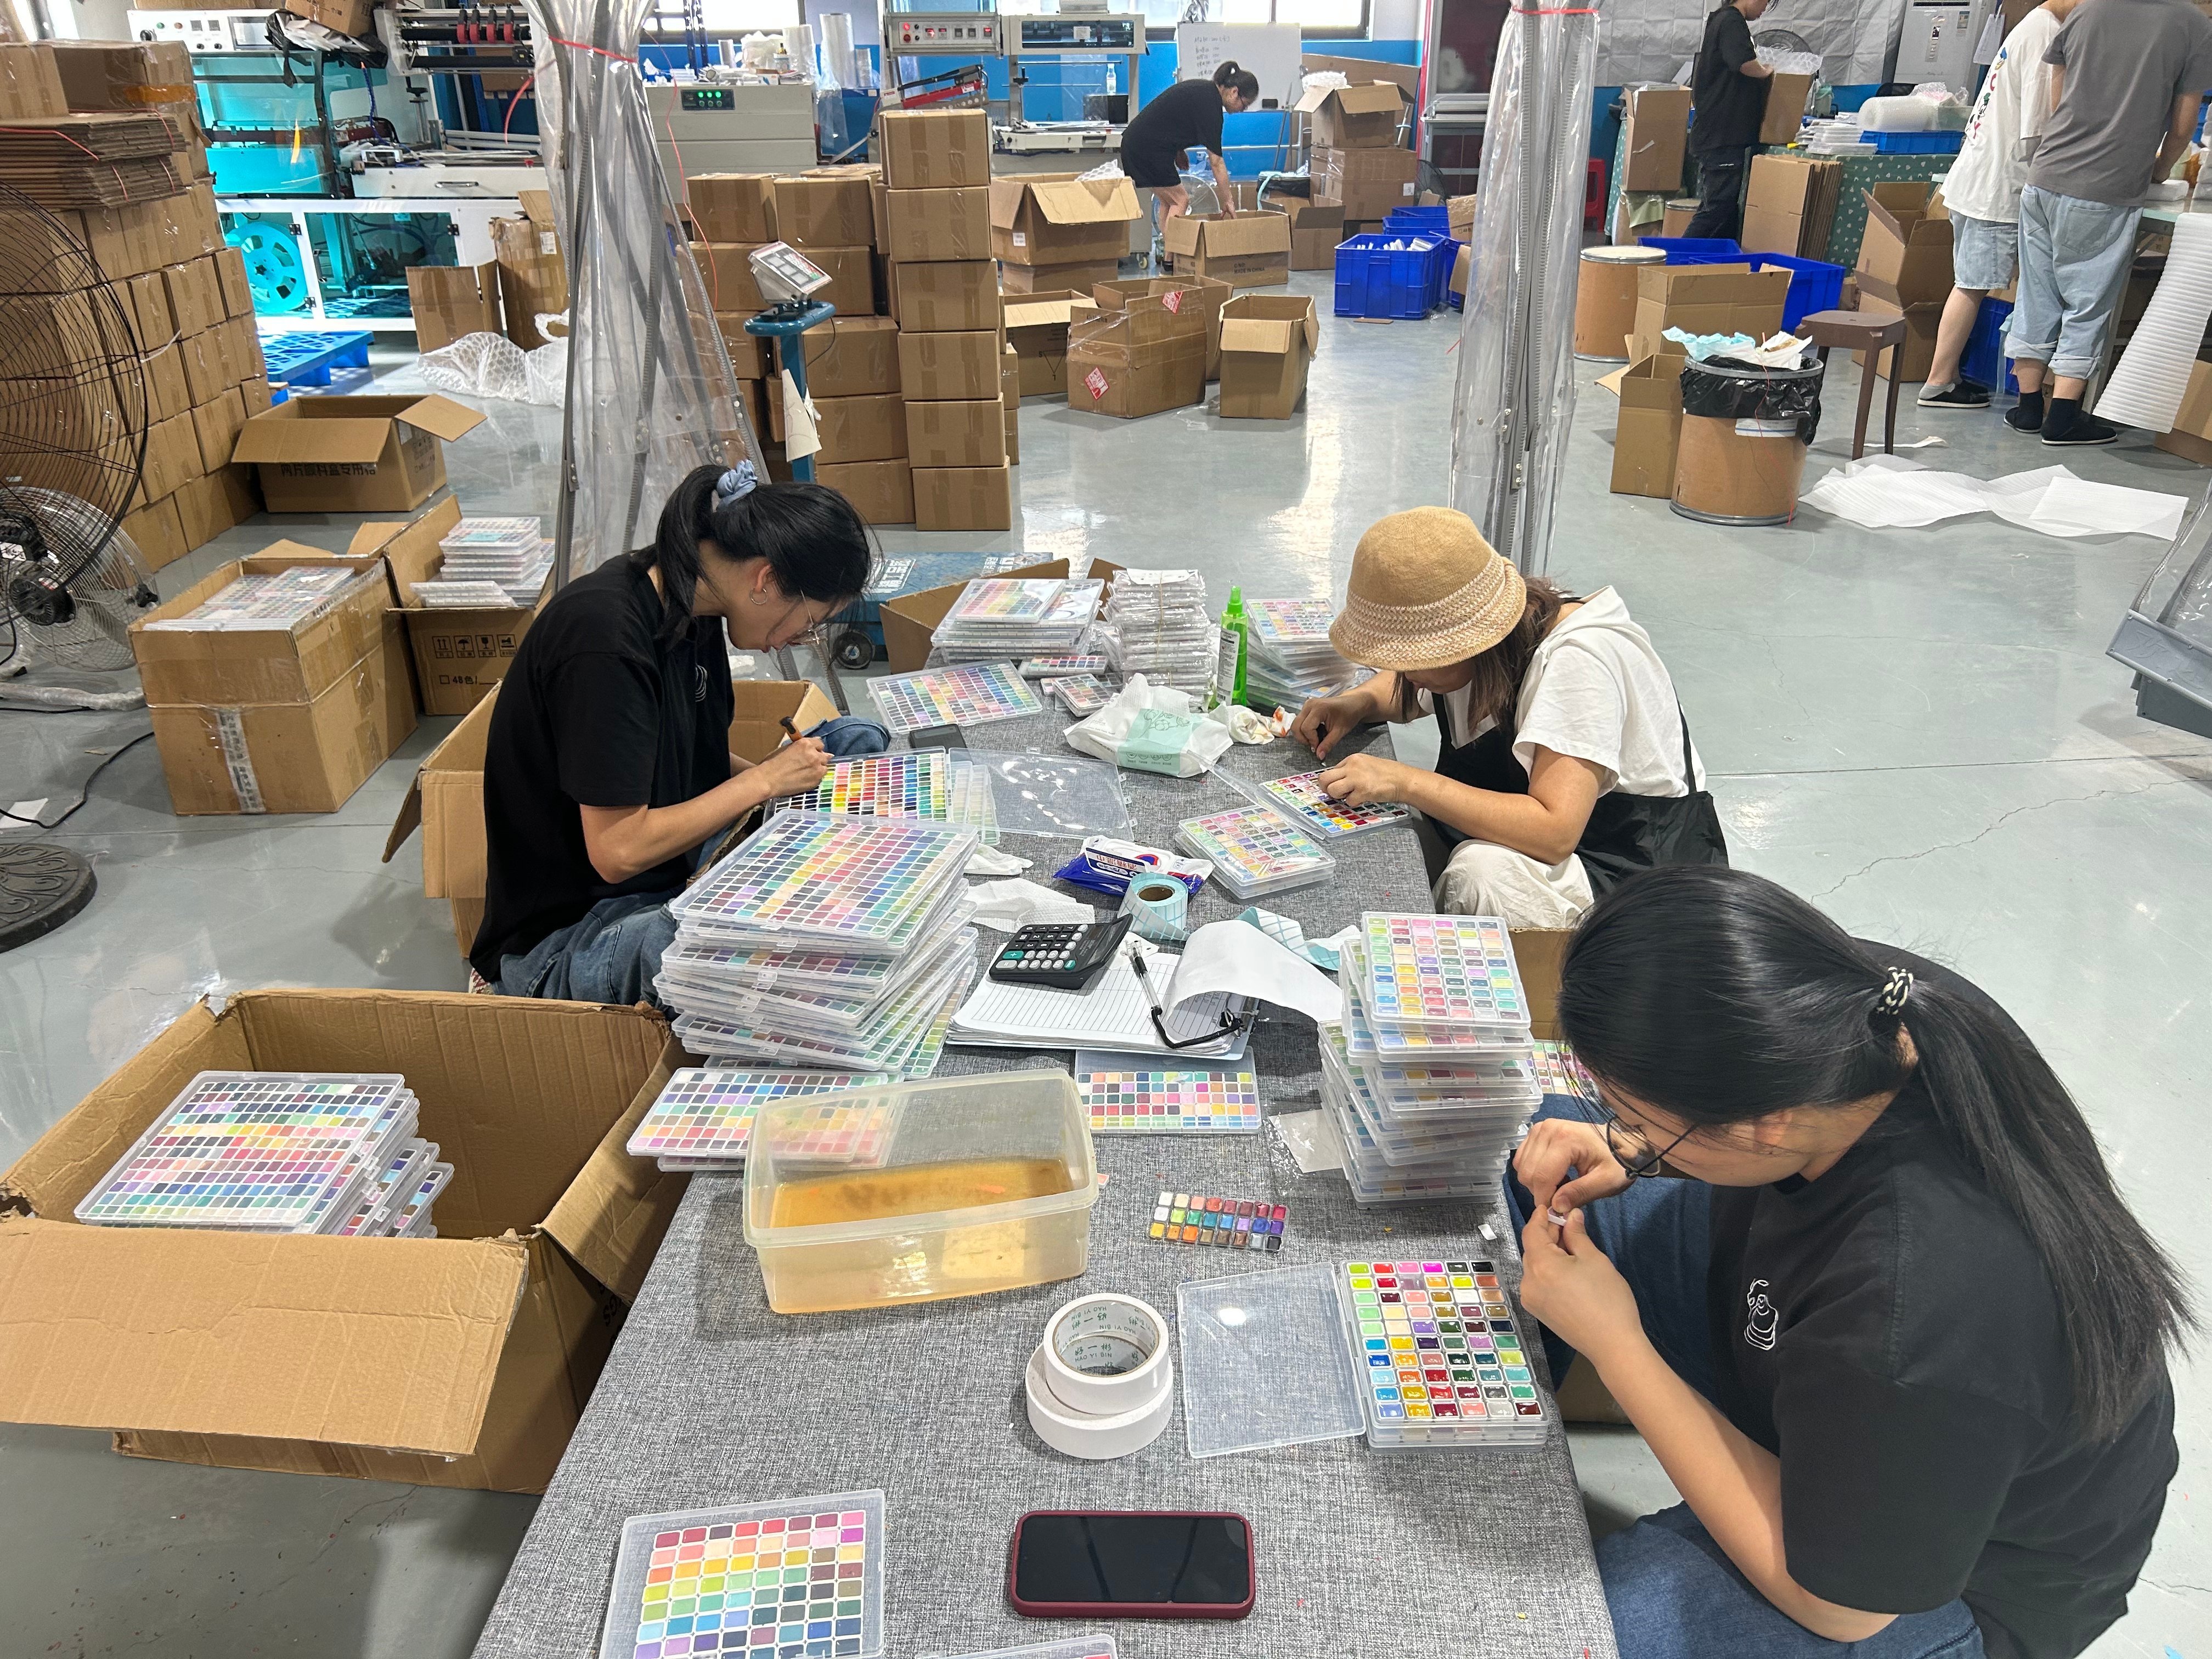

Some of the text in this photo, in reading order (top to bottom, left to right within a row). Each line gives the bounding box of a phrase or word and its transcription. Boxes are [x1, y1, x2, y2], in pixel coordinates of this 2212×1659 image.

[1071, 1312, 1081, 1321] BIN
[1124, 1326, 1136, 1334] HAO
[1075, 1355, 1087, 1363] HAO
